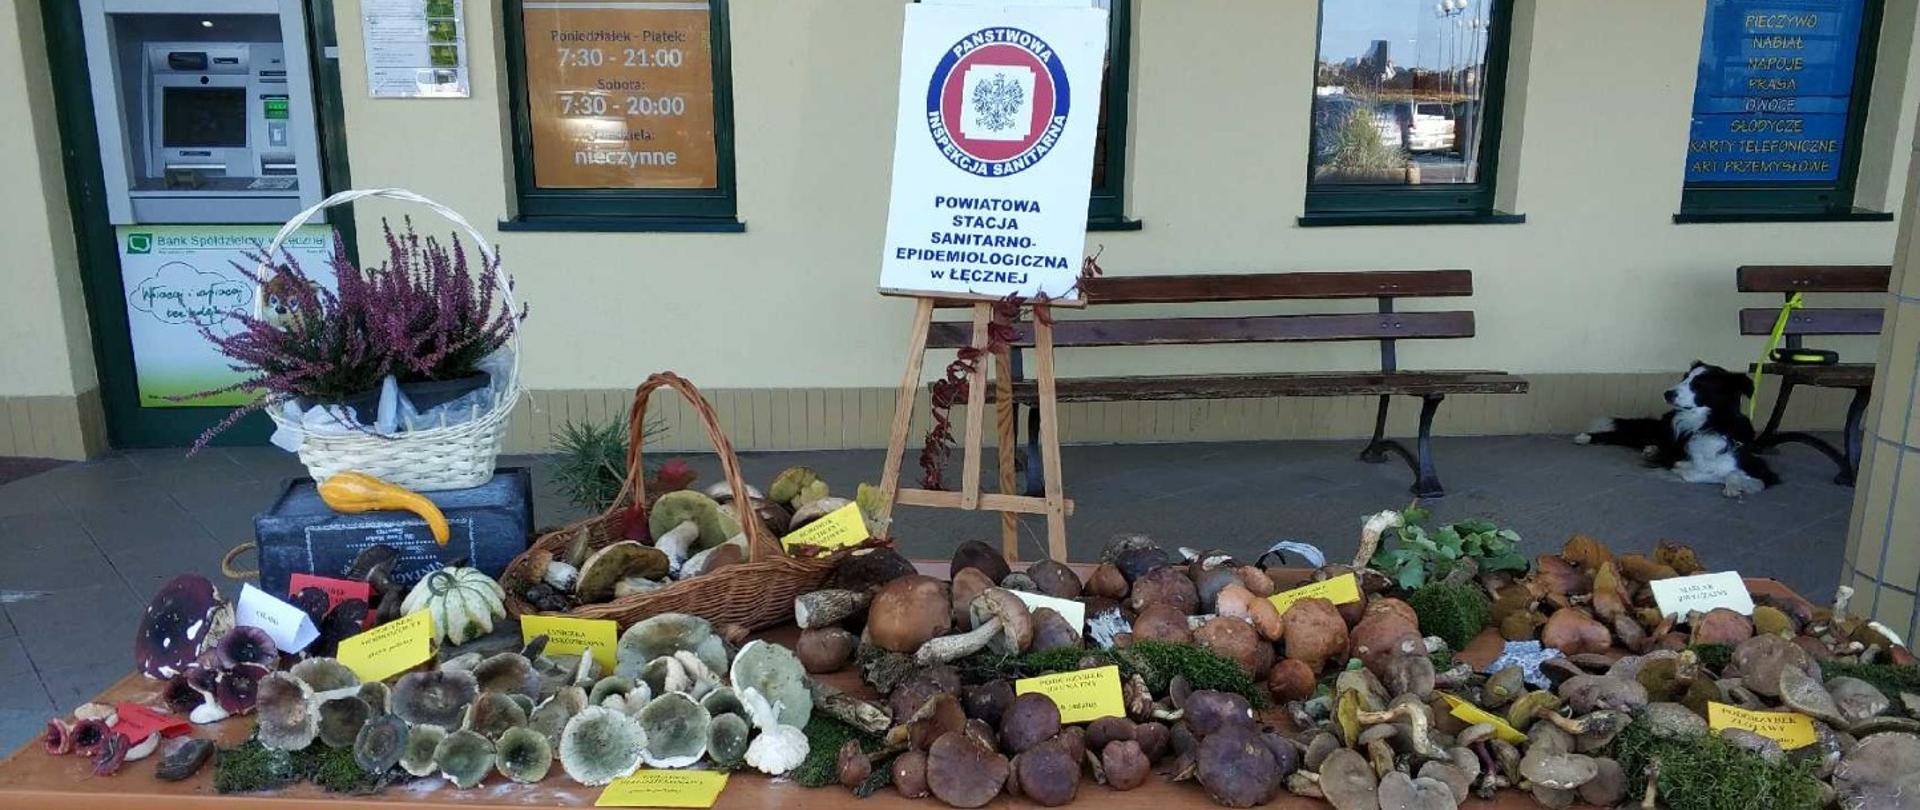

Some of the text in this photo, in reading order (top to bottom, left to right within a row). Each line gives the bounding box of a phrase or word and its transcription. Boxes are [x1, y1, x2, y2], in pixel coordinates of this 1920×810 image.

[1745, 14, 1817, 28] PIECZYWO
[551, 30, 631, 42] Poniedziałek
[642, 30, 686, 43] Piątek:
[1753, 36, 1804, 49] NABIAŁ
[953, 28, 1052, 64] PAŃSTWOWA
[558, 48, 603, 67] 7:30
[623, 48, 683, 67] 21:00
[1748, 56, 1804, 70] NAPOJE
[597, 79, 645, 90] Sobota:
[1748, 79, 1796, 90] PRASA
[561, 96, 607, 115] 7:30
[627, 96, 685, 115] 20:00
[1745, 99, 1796, 112] OWOCE
[1730, 119, 1803, 133] SŁODYCZE
[929, 111, 1066, 175] INSPEKCJA SANITARNA
[1690, 139, 1837, 152] KARTY TELEFONICZNE
[575, 149, 677, 168] nieczynne
[1723, 160, 1830, 172] PRZEMYSŁOWE
[935, 196, 1041, 213] POWIATOWA
[952, 215, 1018, 230] STACJA
[157, 236, 188, 246] Bank
[190, 236, 263, 247] Spółdzielczy
[931, 232, 1036, 249] SANITARNO-
[896, 248, 1068, 269] EPIDEMIOLOGICZNA
[931, 269, 1028, 285] w ŁĘCZNEJ
